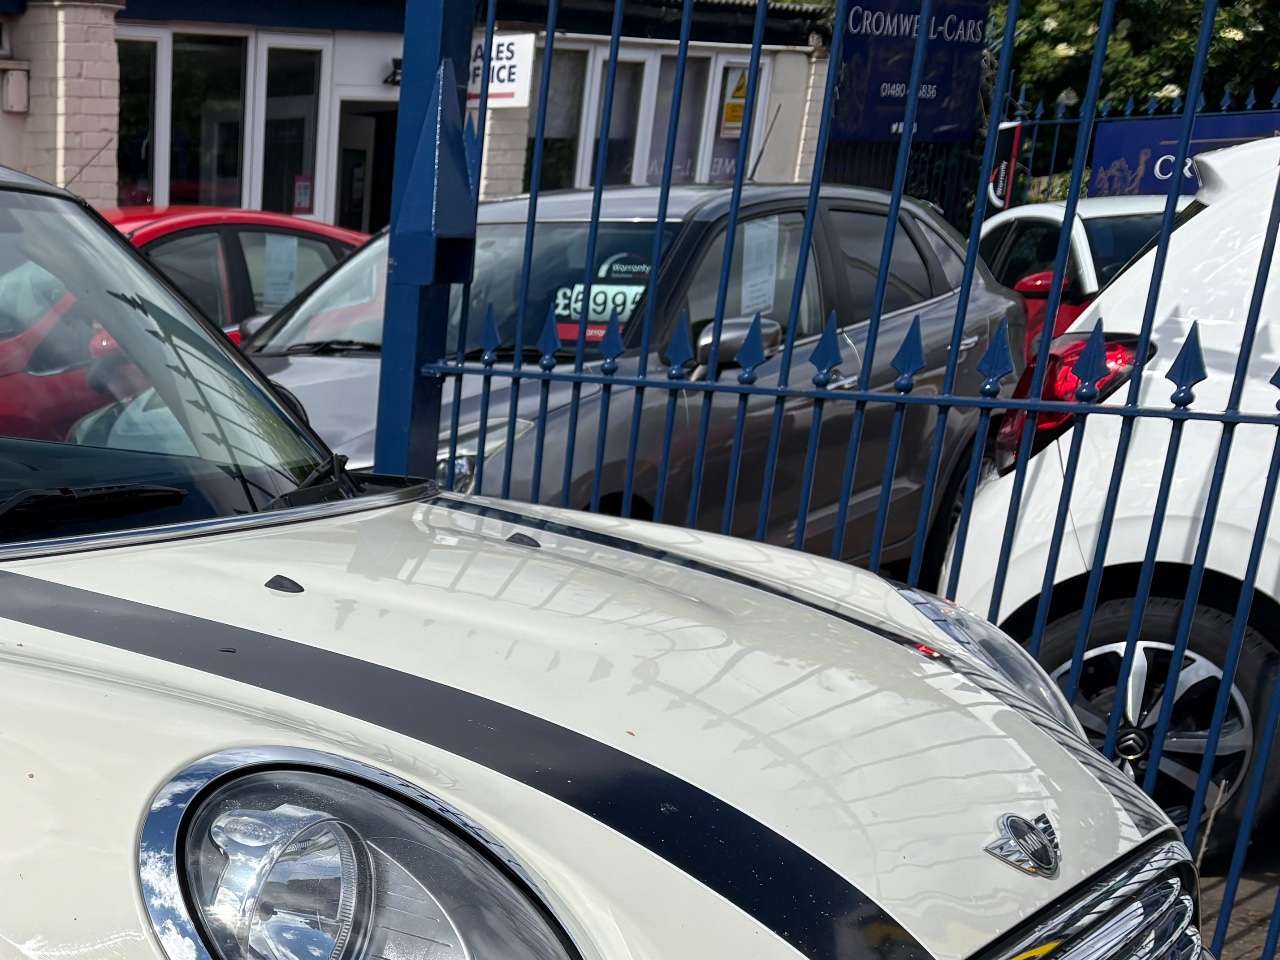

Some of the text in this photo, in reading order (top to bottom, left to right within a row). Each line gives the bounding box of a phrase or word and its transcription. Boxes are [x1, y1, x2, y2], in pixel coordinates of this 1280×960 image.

[848, 5, 984, 43] CROMWEL-CARS
[473, 41, 516, 63] AES
[470, 63, 518, 84] FICE
